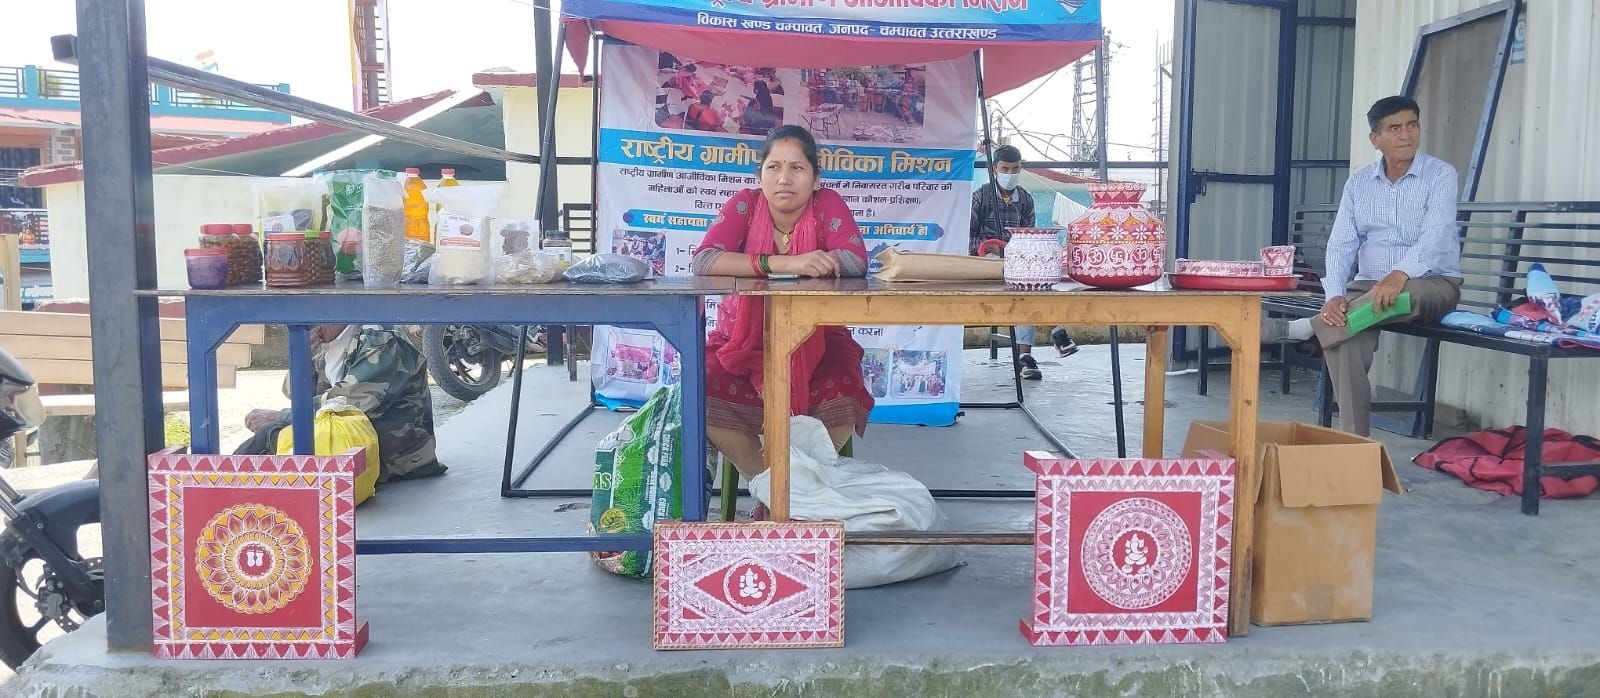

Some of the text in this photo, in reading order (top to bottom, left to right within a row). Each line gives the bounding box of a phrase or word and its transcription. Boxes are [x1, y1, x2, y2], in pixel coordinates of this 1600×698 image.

[697, 11, 737, 28] विकास
[741, 19, 773, 30] खण्ड
[879, 25, 926, 38] चम्पावत
[929, 27, 998, 39] उत्तराखण्ड
[620, 136, 695, 164] राष्ट्रीय
[890, 150, 955, 173] मिशन
[619, 167, 645, 177] राष्ट्रीय
[646, 168, 674, 178] ग्रामीण
[676, 171, 716, 182] आजीविका
[718, 173, 742, 184] मिशन
[851, 181, 887, 189] निवासरत
[889, 181, 911, 190] गरीब
[912, 181, 940, 190] परिवार
[858, 327, 884, 337] करना
